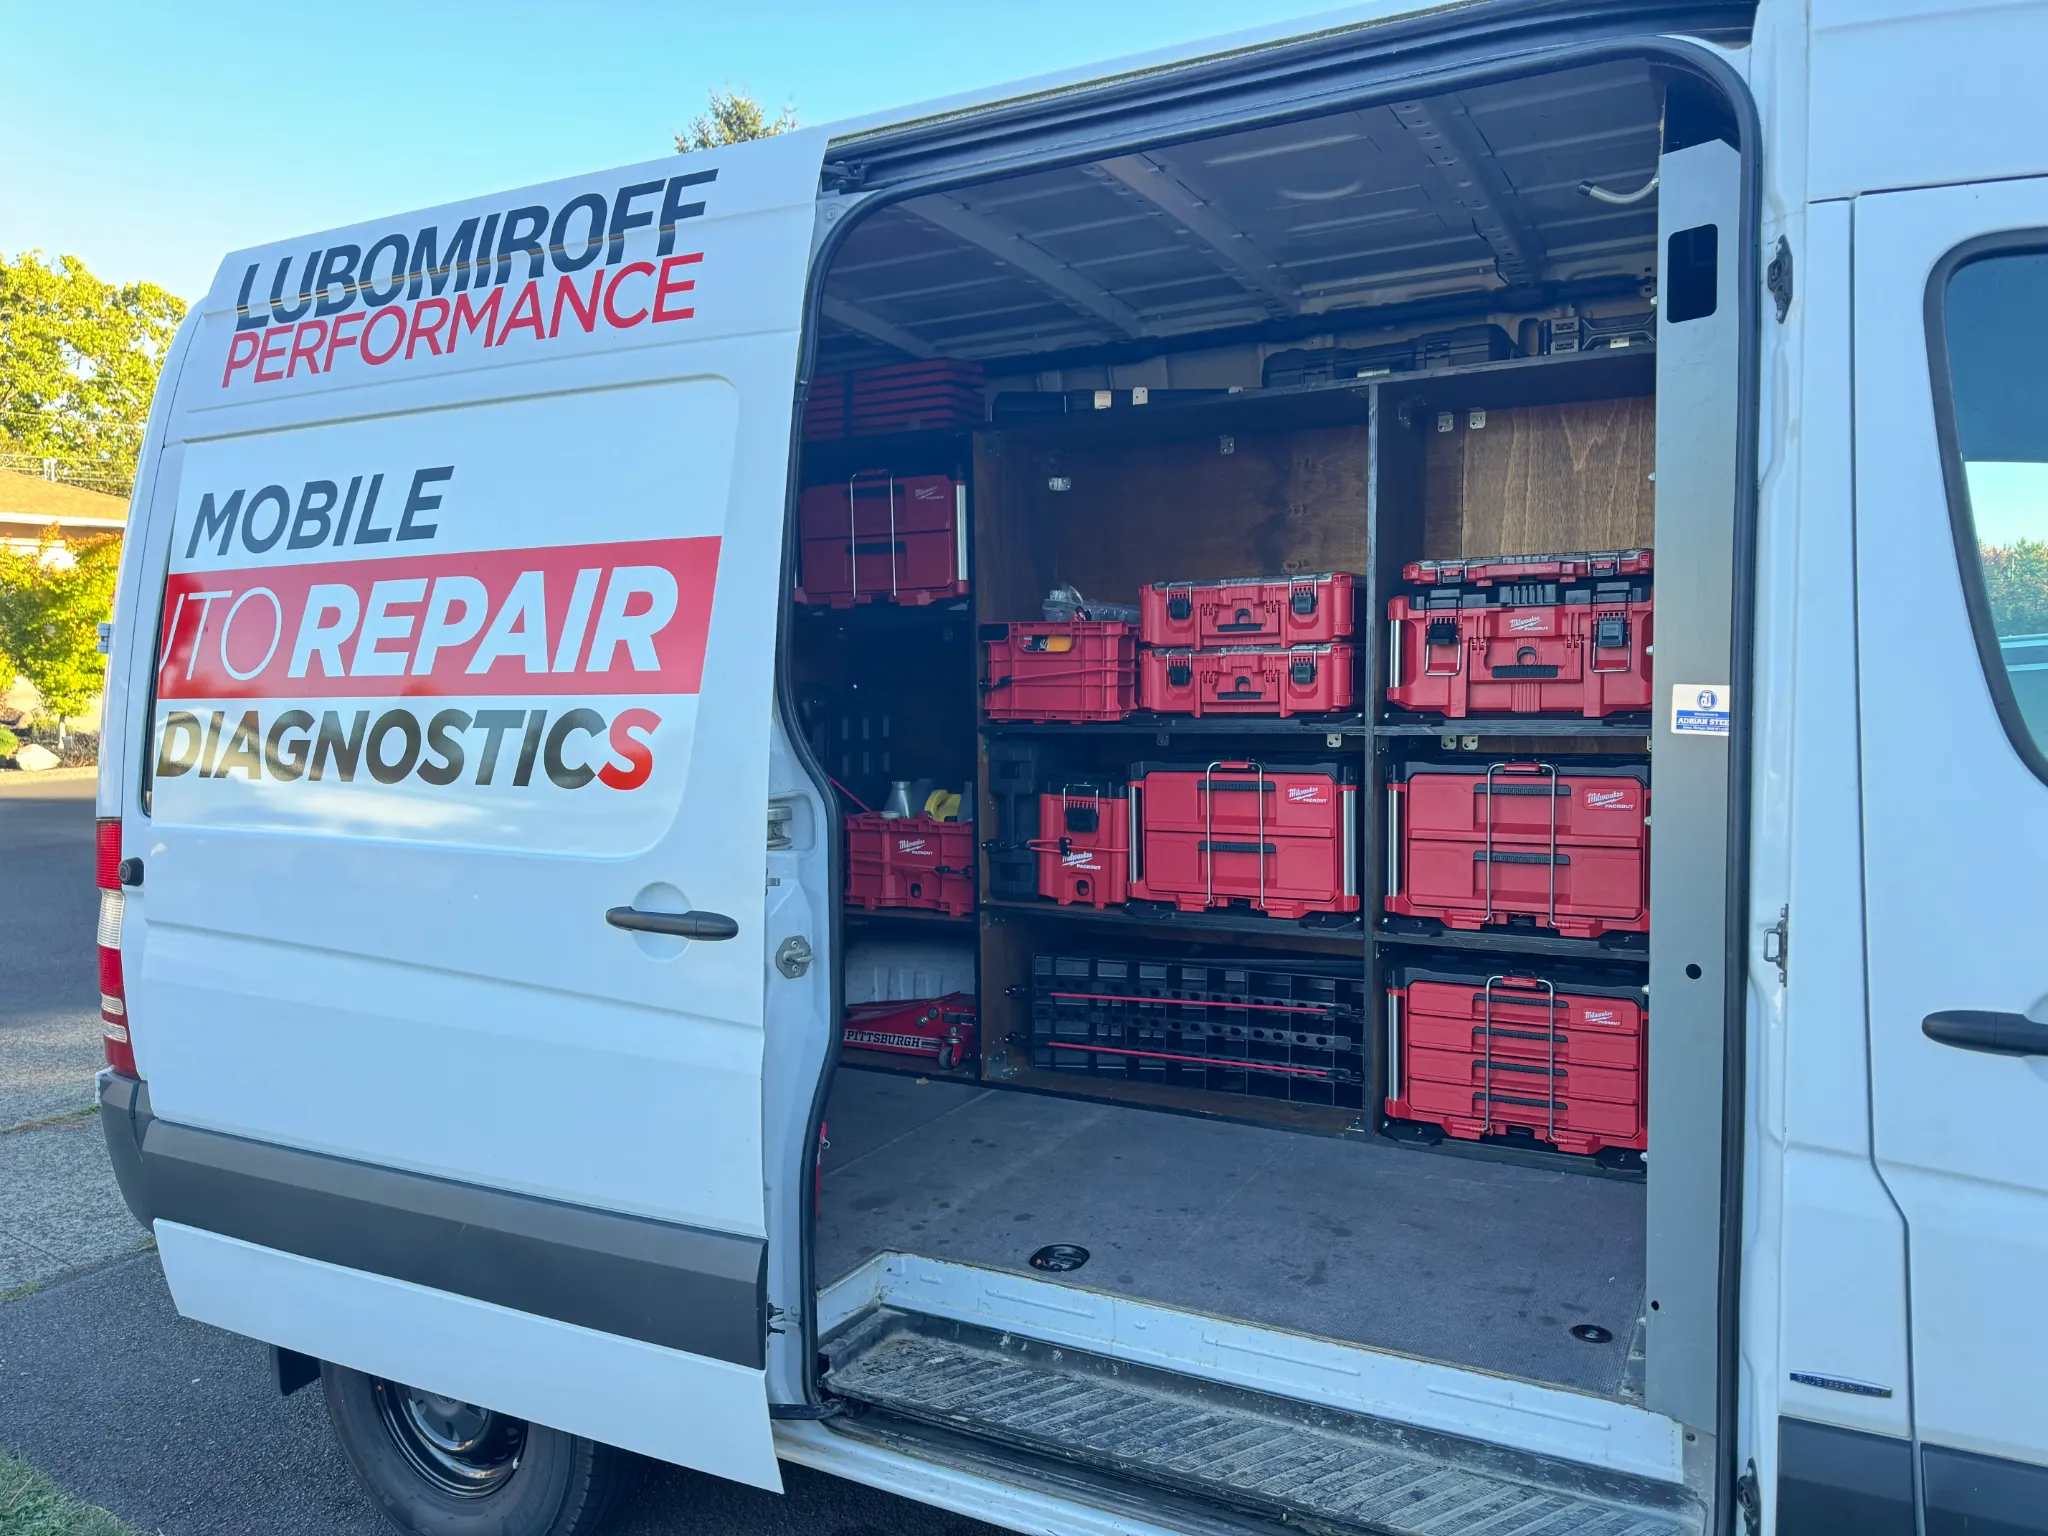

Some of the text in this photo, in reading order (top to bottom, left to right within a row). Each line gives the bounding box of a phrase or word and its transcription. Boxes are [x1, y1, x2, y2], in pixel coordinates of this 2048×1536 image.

[235, 168, 719, 332] LUBOMIROFF
[221, 252, 705, 389] PERFORMANCE
[185, 465, 455, 559] MOBILE
[287, 565, 679, 679] REPAIR
[156, 707, 662, 791] DIAGNOSTICS
[1677, 717, 1708, 725] ADRIAN
[1288, 786, 1319, 799] Milwaukee
[1586, 791, 1625, 803] Milwaukee
[846, 1030, 921, 1048] PITTSBURGH
